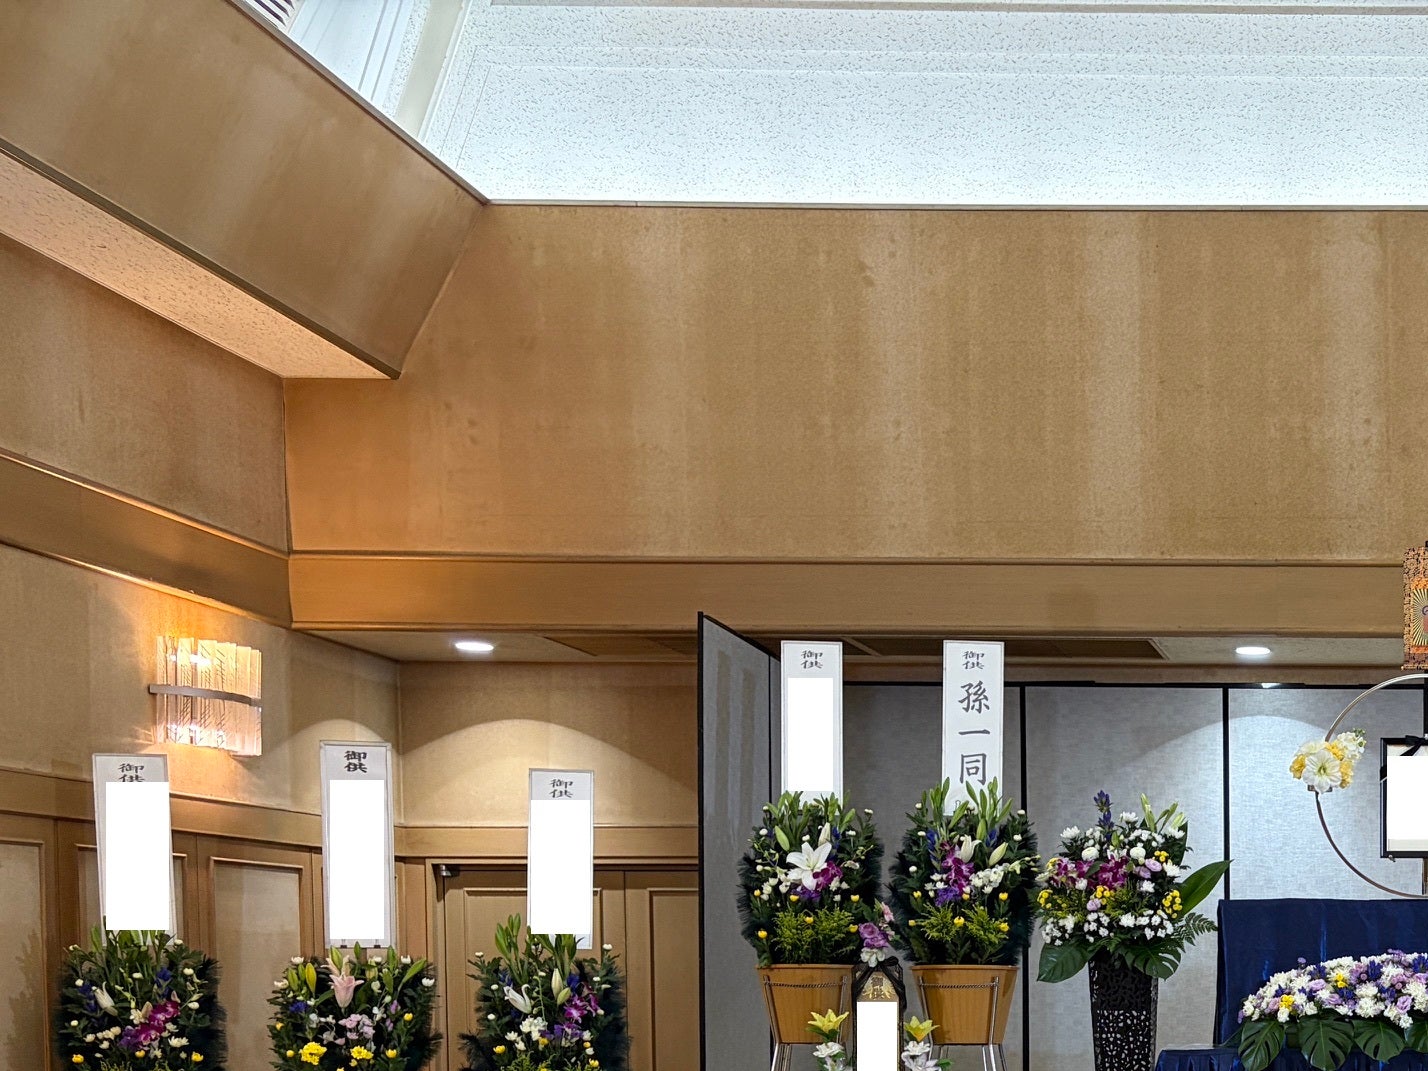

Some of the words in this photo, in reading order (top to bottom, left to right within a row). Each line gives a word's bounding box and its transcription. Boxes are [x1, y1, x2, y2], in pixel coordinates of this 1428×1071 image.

[800, 651, 824, 669] 御供
[962, 651, 985, 670] 御供
[958, 680, 991, 786] 孫一同
[343, 750, 368, 773] 御供
[550, 778, 574, 798] 御供
